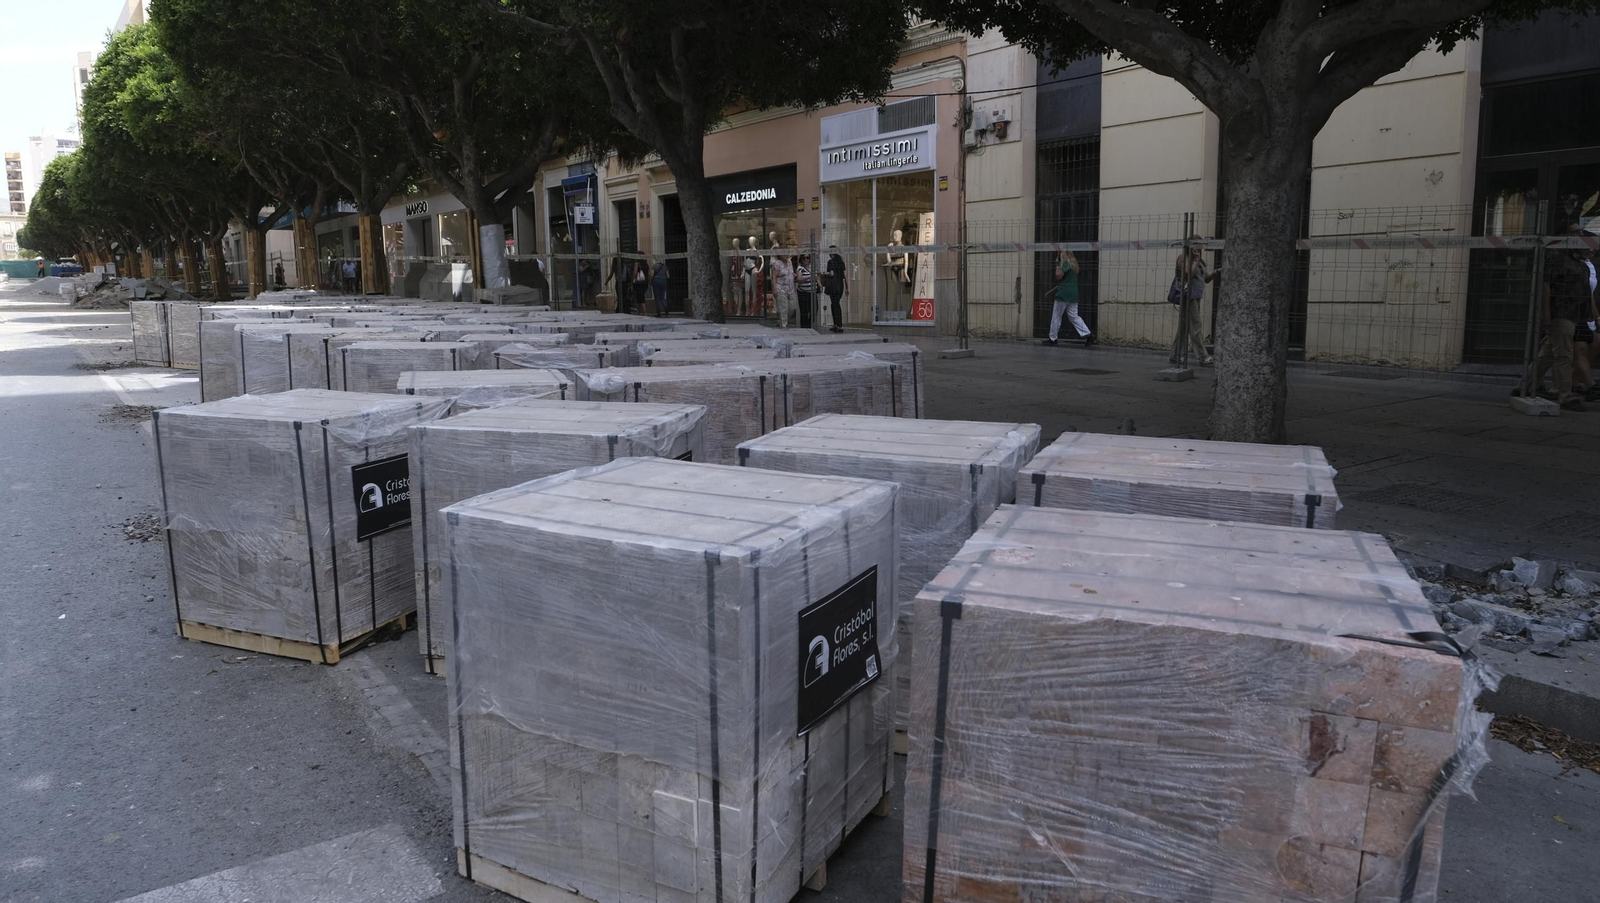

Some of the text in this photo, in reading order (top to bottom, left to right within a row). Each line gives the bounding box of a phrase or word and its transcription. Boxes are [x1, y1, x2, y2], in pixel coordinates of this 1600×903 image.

[827, 138, 918, 165] intimissimi
[862, 154, 918, 171] Italian lingerie
[726, 188, 776, 204] CALZEDONIA
[919, 217, 932, 297] REAJA
[834, 601, 874, 644] Cristóbal
